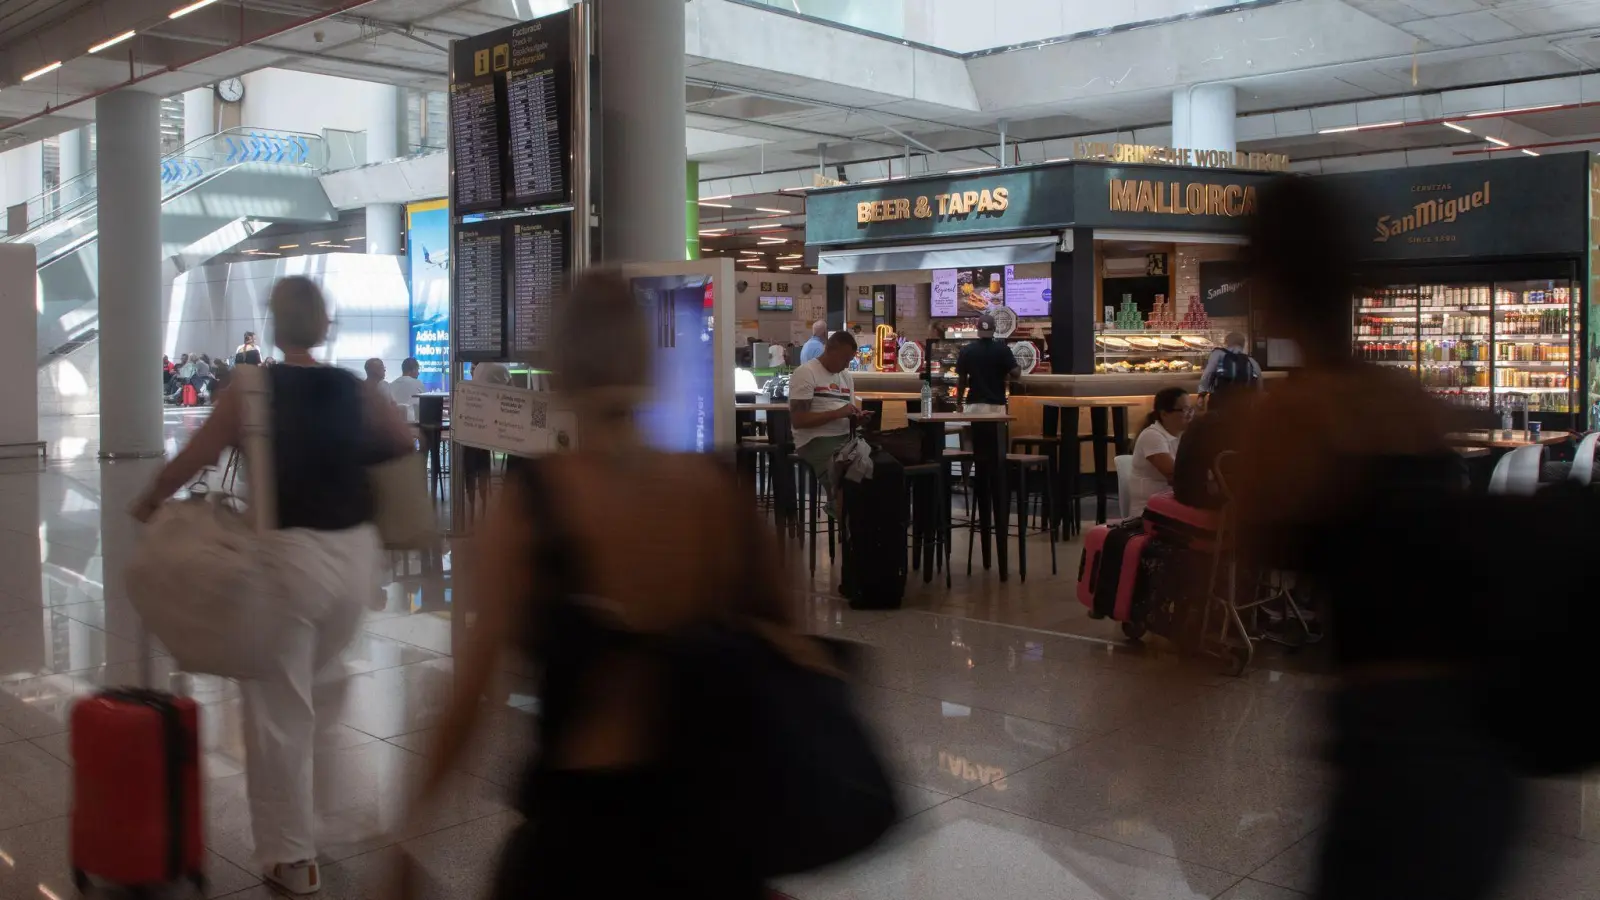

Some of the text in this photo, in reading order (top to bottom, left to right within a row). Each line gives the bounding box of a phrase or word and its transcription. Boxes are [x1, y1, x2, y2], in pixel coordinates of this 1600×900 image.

[512, 22, 542, 37] Facturació
[1195, 149, 1248, 169] WORLD
[1249, 152, 1289, 173] FROM
[857, 187, 1010, 224] BEER & TAPAS
[1109, 178, 1258, 218] MALLORCA
[416, 329, 436, 341] Adiós
[416, 343, 435, 355] Hello
